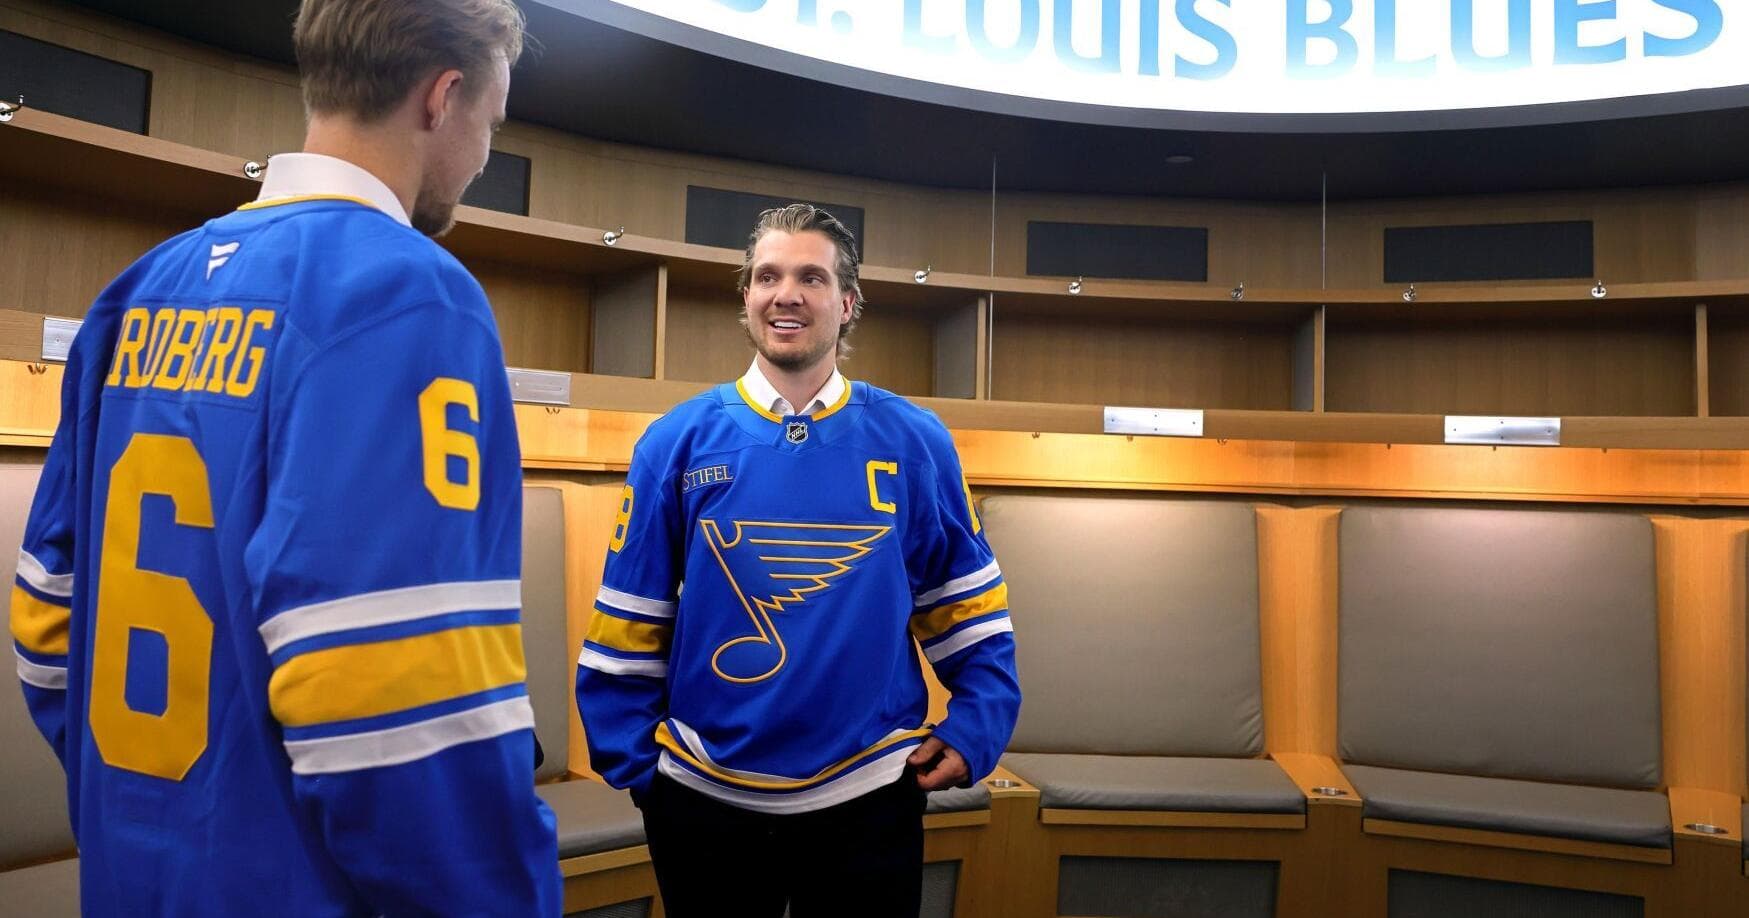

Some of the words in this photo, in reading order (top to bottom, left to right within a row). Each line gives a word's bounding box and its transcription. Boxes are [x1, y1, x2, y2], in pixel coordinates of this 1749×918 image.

[902, 0, 1239, 81] LOUIS
[1286, 0, 1725, 80] BLUES
[105, 306, 275, 398] ROBERG
[418, 376, 481, 511] 6
[683, 465, 734, 491] STIFEL
[610, 484, 634, 554] 8
[866, 459, 898, 514] C
[89, 432, 215, 781] 6
